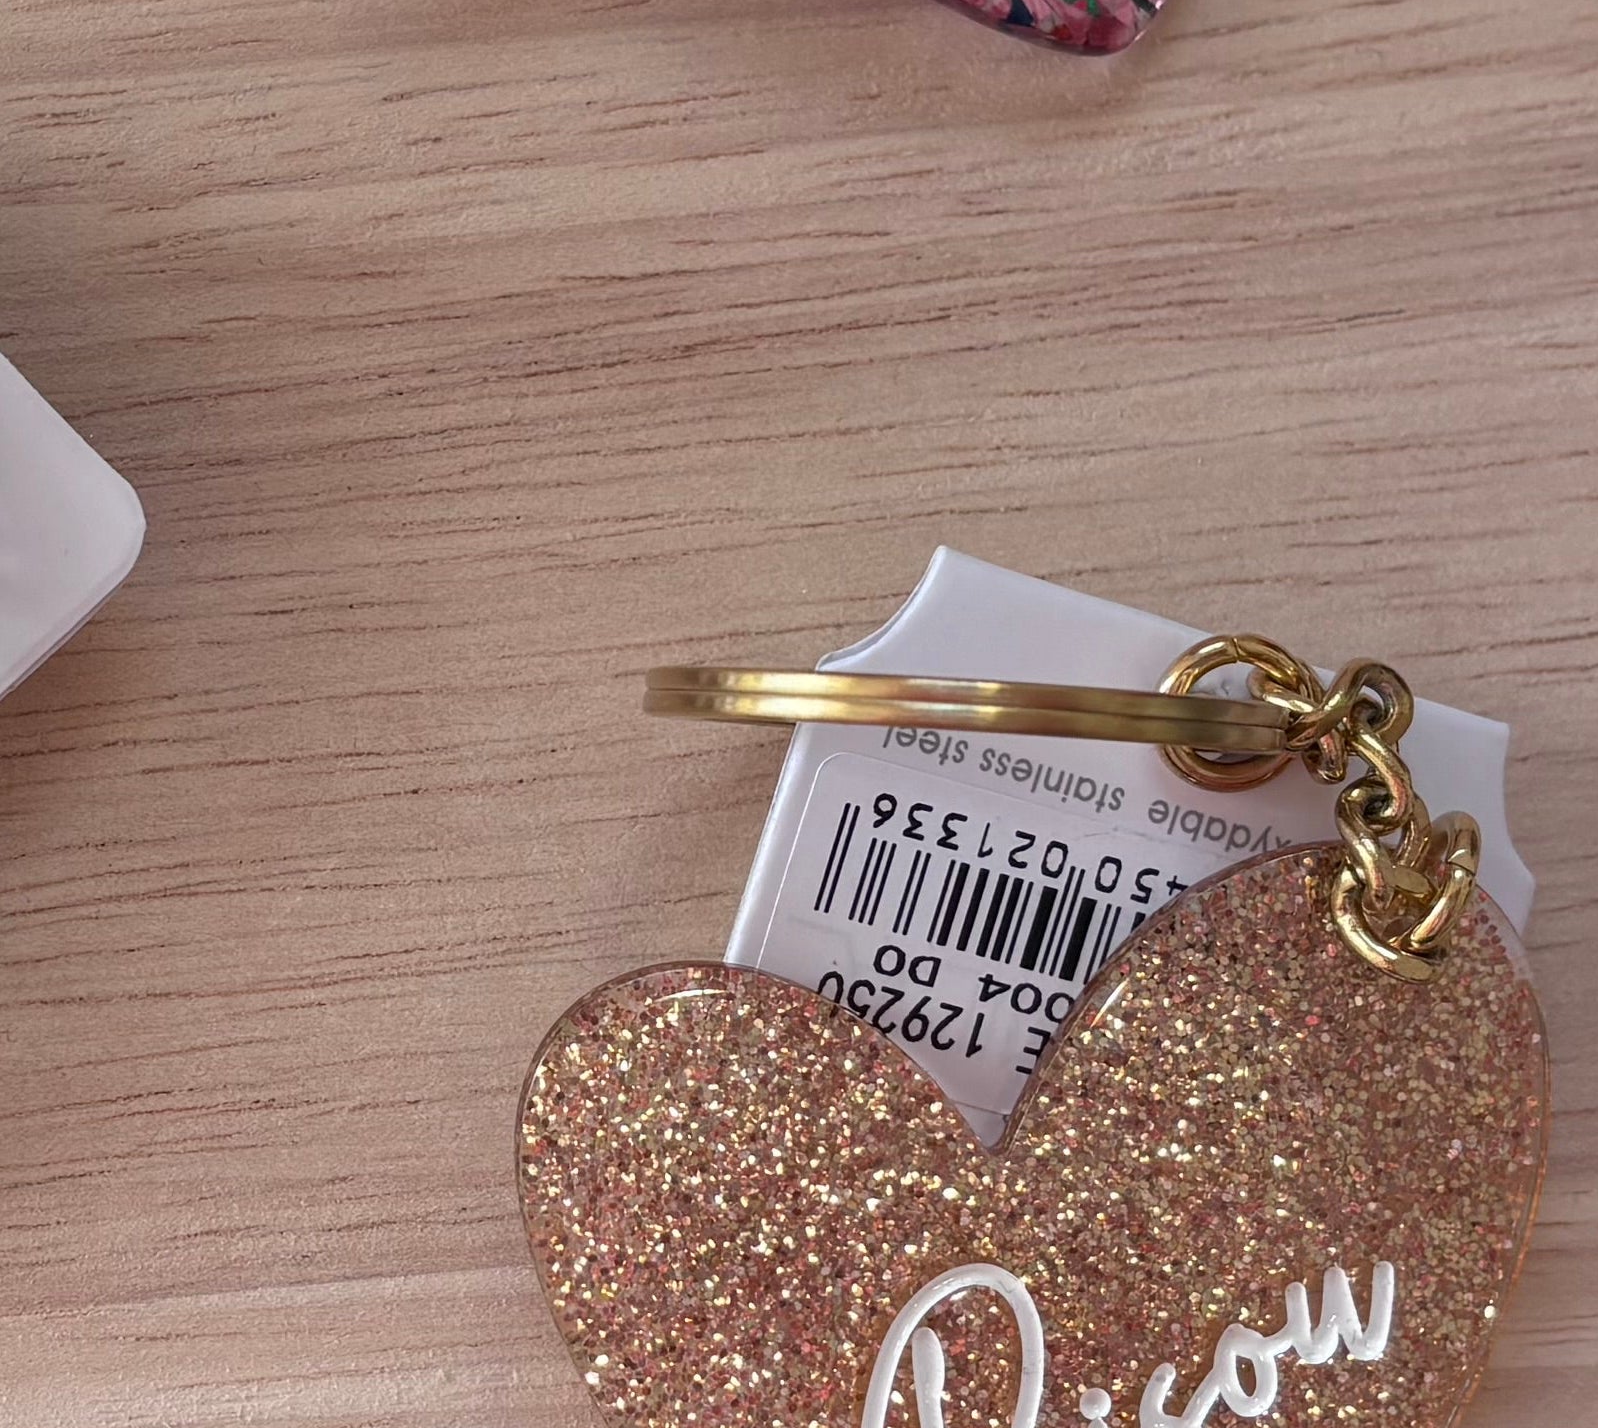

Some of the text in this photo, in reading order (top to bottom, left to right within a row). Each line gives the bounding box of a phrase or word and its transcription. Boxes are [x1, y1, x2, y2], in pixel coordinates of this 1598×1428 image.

[883, 725, 970, 767] steel
[978, 746, 1127, 817] stainless
[871, 791, 1069, 880] 021336
[814, 969, 986, 1059] 129250
